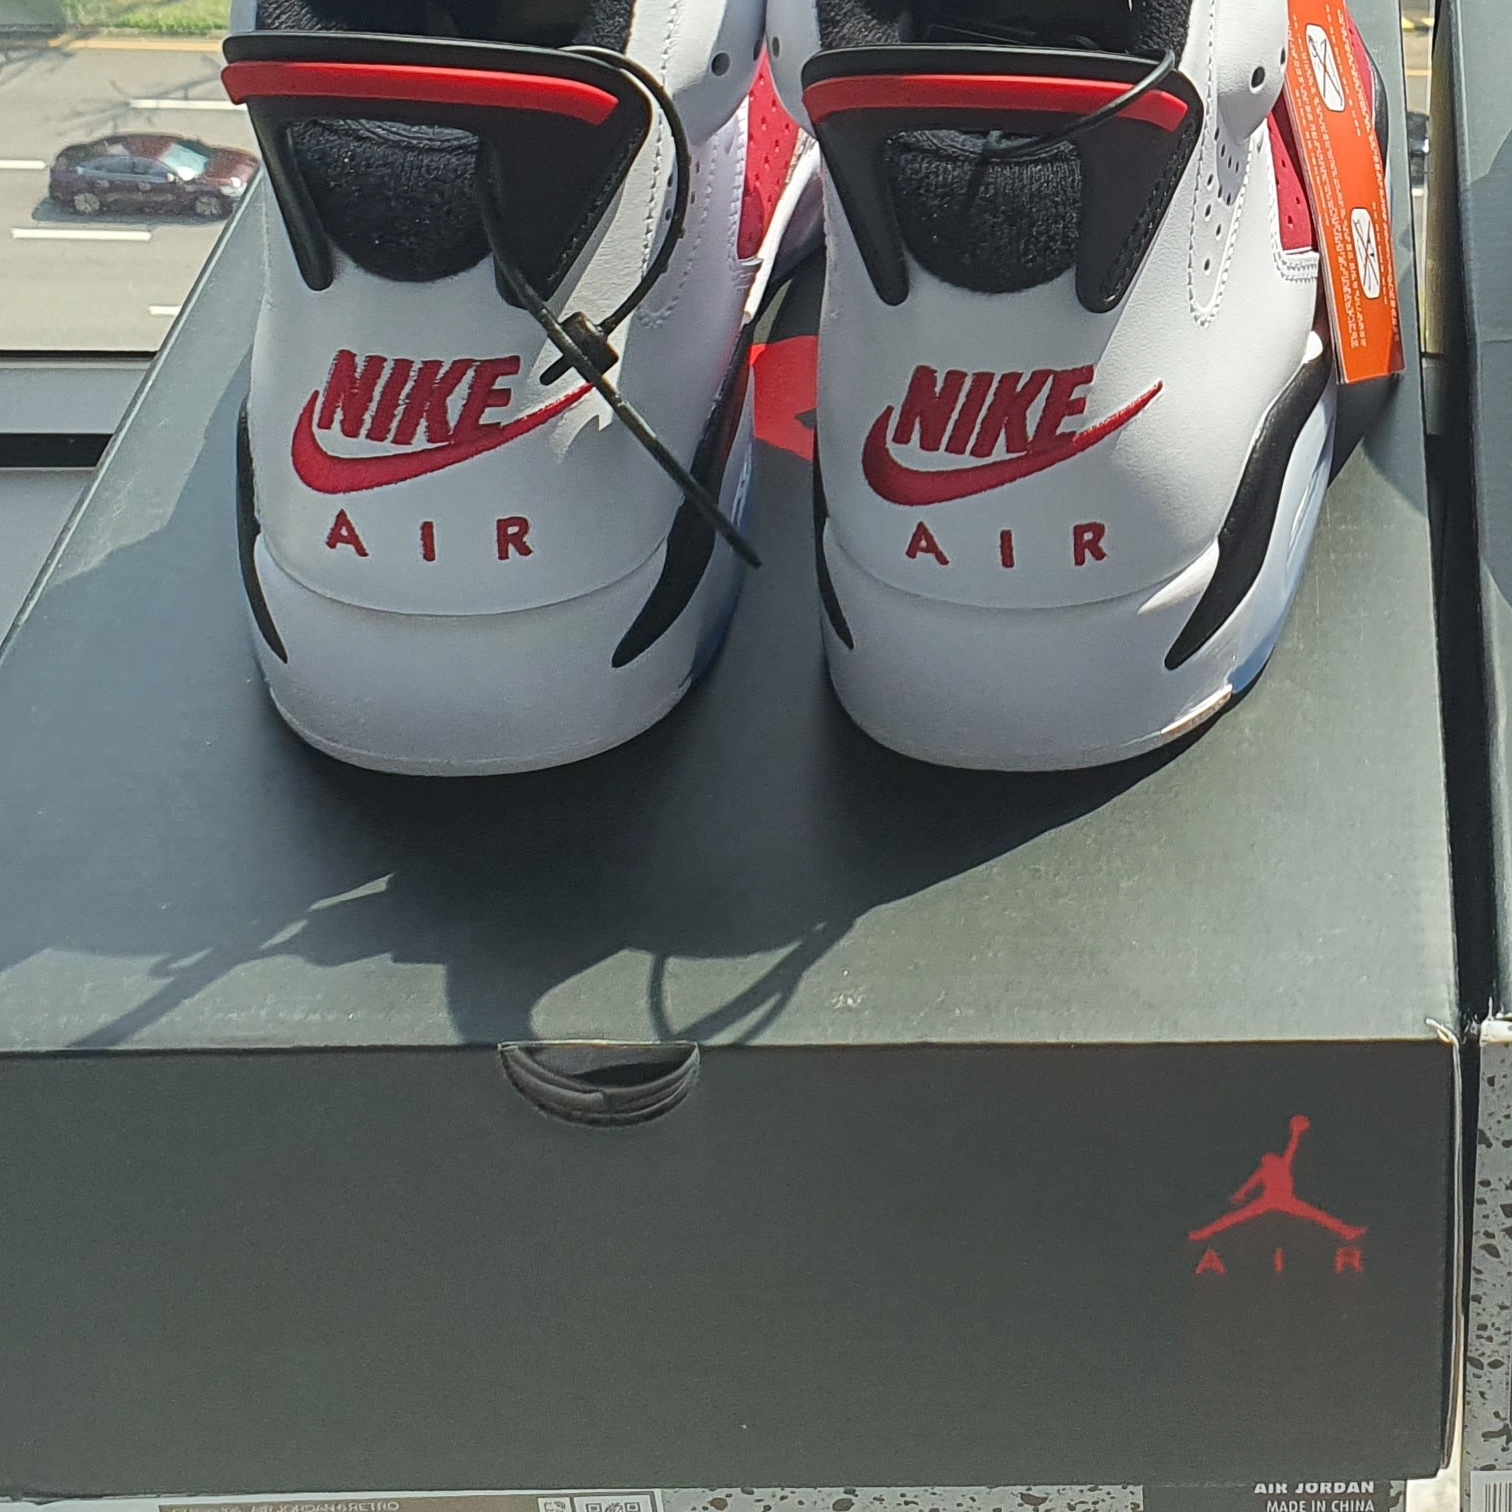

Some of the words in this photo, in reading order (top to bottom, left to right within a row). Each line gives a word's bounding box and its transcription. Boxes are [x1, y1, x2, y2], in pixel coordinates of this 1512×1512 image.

[317, 349, 521, 445] NIKE
[891, 364, 1095, 458] NIKE
[326, 509, 534, 562] AIR
[905, 521, 1108, 569] AIR
[1195, 1247, 1364, 1274] AIR
[1254, 1482, 1288, 1494] AIR
[1295, 1481, 1375, 1494] JORDAN
[1267, 1500, 1307, 1512] MADE
[1312, 1500, 1326, 1512] IN
[1331, 1499, 1375, 1512] CHINA
